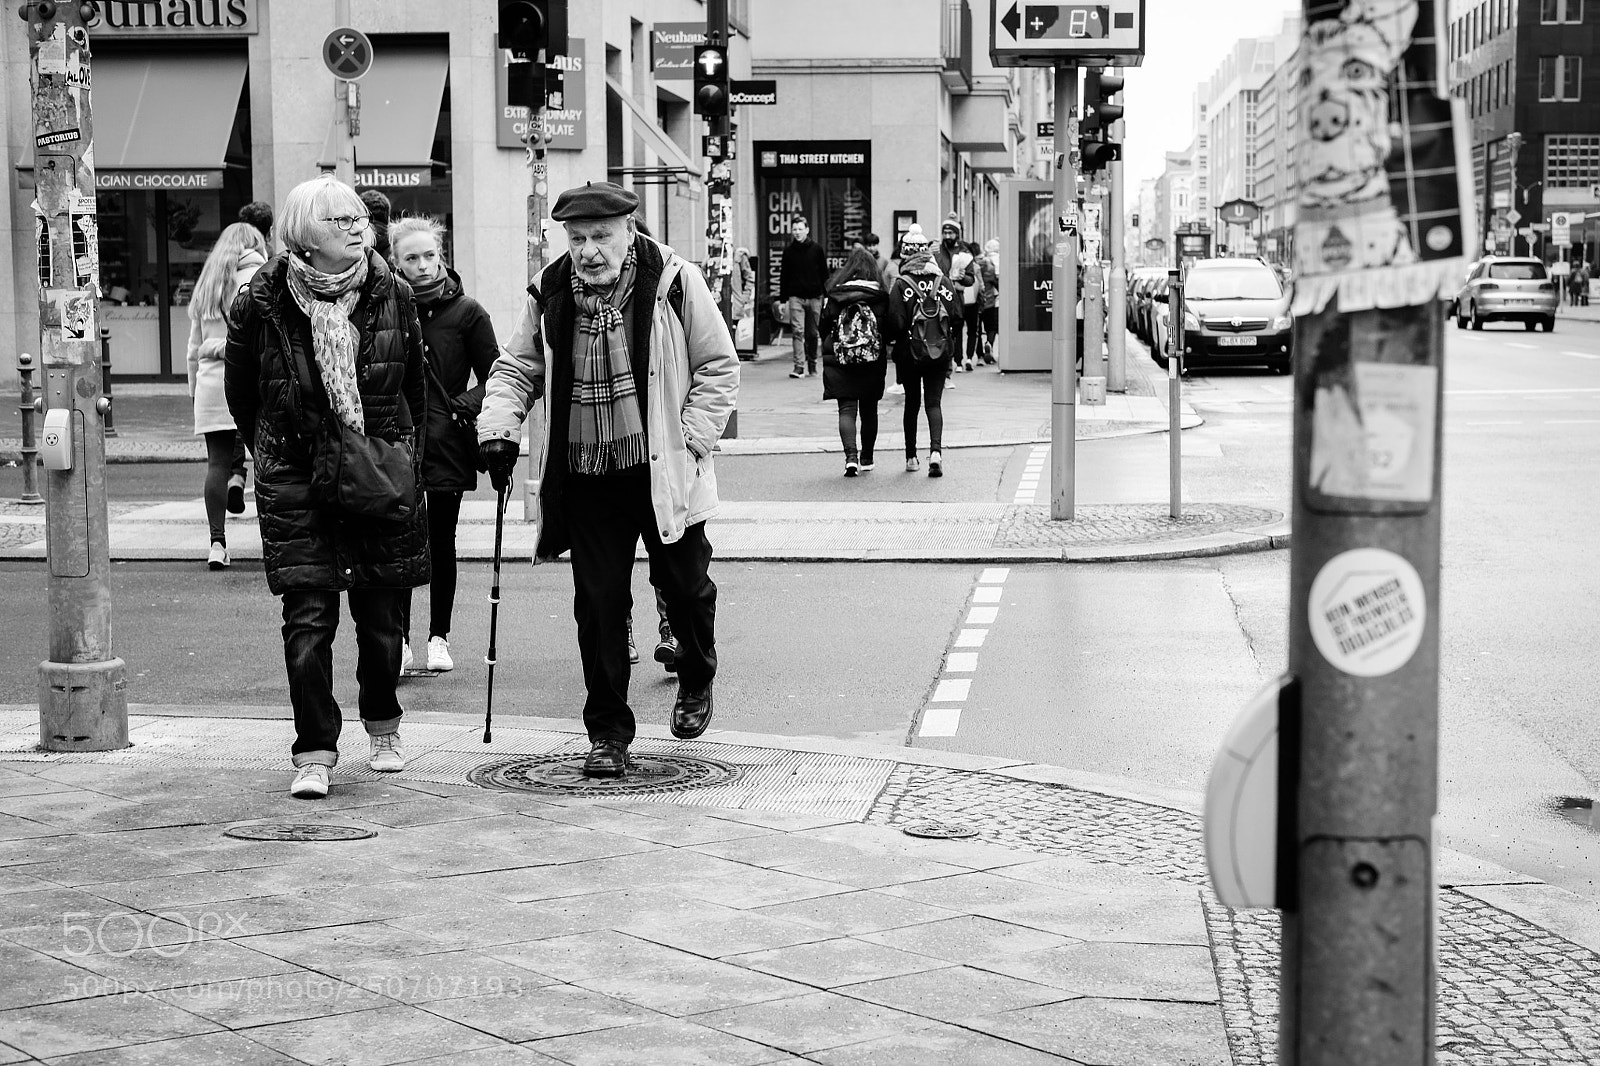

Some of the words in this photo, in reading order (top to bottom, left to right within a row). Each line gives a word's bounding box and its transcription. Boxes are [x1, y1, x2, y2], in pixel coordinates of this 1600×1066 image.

[729, 92, 775, 105] oConcept
[504, 107, 582, 121] EXTRDINARY
[512, 122, 575, 136] CHOLATE
[779, 154, 798, 164] THAI
[799, 154, 829, 164] STREET
[830, 153, 864, 164] KITCHEN
[134, 174, 208, 187] CHOCOLATE
[769, 192, 803, 212] CHA
[1234, 204, 1244, 216] U
[768, 213, 802, 234] CH
[827, 257, 849, 269] FRE
[769, 249, 784, 297] MACHT
